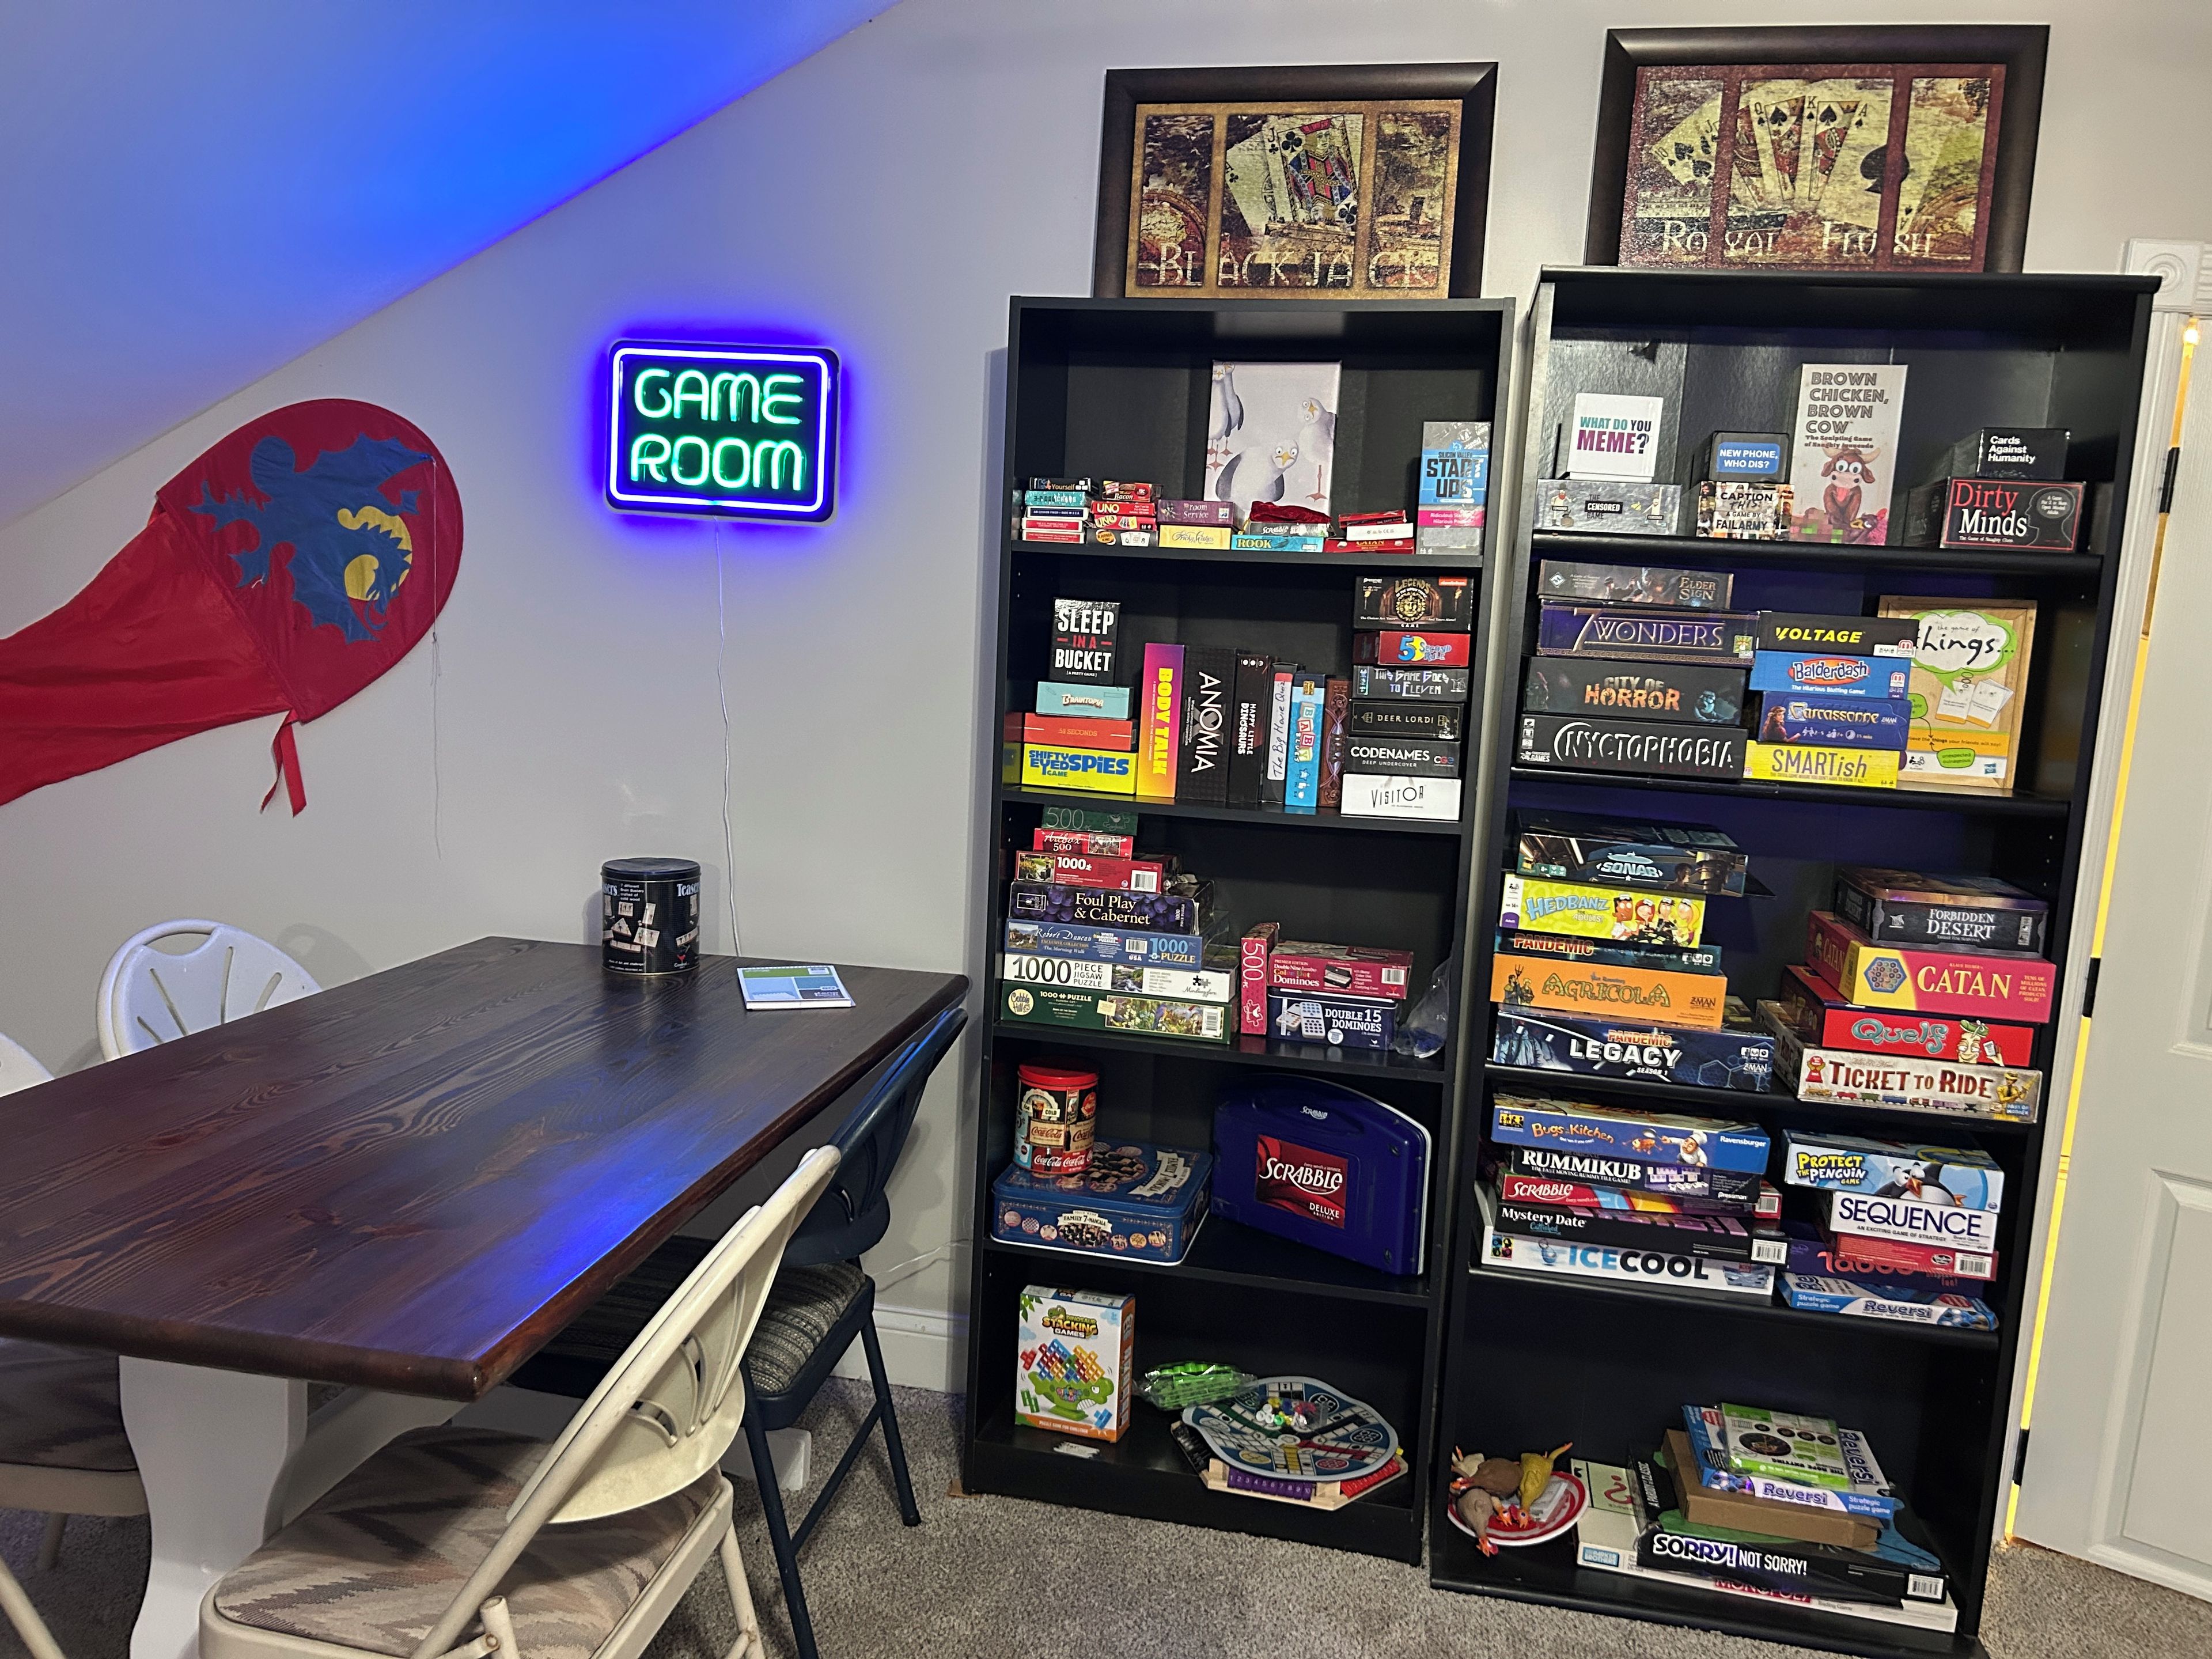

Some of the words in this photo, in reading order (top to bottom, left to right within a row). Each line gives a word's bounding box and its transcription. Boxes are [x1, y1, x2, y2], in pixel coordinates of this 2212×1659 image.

[1158, 242, 1294, 286] BLACK
[1305, 250, 1432, 287] JACK
[1811, 372, 1877, 387] BROWN
[634, 369, 804, 425] GAME
[1809, 388, 1889, 404] CHICKEN,
[1807, 404, 1873, 418] BROWN
[1580, 416, 1611, 429] WHAT
[1612, 418, 1628, 431] DO
[1630, 419, 1652, 432] YOU
[1805, 421, 1850, 434] COW
[1576, 429, 1650, 454] MEME?
[1990, 435, 2021, 444] Cards
[1719, 449, 1741, 457] NEW
[1743, 450, 1778, 459] PHONE,
[1988, 445, 2027, 454] Against
[630, 433, 803, 491] ROOM
[1724, 460, 1747, 468] WHO
[1748, 460, 1770, 469] DIS?
[1987, 453, 2036, 464] Humanity
[1426, 458, 1484, 478] START
[1435, 479, 1474, 498] UPS
[1721, 492, 1773, 501] CAPTION
[1587, 502, 1621, 512] CENSORED
[1953, 483, 2019, 517] Dirty
[1096, 503, 1120, 514] UNO
[1183, 511, 1209, 519] Service
[1094, 514, 1118, 528] UNO
[1958, 508, 2028, 537] Minds
[1236, 538, 1272, 549] ROOK
[1395, 578, 1432, 594] LEGENDS
[1679, 576, 1717, 591] ELDER
[1679, 589, 1715, 601] SIGN
[1057, 608, 1115, 635] SLEEP
[1073, 635, 1086, 648] IN
[1089, 636, 1097, 649] A
[1775, 627, 1862, 643] VOLTAGE
[1055, 648, 1112, 672] BUCKET
[1373, 668, 1393, 680] THIS
[1395, 669, 1421, 683] GAME
[1422, 671, 1449, 684] GOES
[1793, 660, 1869, 681] Balderdash
[1389, 683, 1401, 693] TO
[1402, 681, 1442, 697] ELEVEN
[1603, 676, 1641, 690] CITY
[1643, 677, 1664, 690] OF
[1827, 686, 1848, 694] Bluffing
[1156, 668, 1173, 724] BODY
[1275, 681, 1286, 702] Quiz
[1584, 683, 1681, 711] HORROR
[1062, 694, 1104, 708] BRAINTOPIA
[1248, 703, 1257, 728] HAPPY
[1274, 707, 1285, 733] Movie
[1789, 702, 1880, 724] Carcassonne
[1191, 671, 1223, 773] ANOMIA
[1237, 702, 1250, 755] DINOSAURS
[1298, 707, 1315, 758] BABY
[1246, 730, 1255, 755] LITTLE
[1272, 736, 1286, 755] Big
[1294, 732, 1302, 763] BLUES
[1152, 726, 1170, 776] TALK
[1531, 755, 1550, 763] GAMES
[1030, 757, 1070, 776] EYED
[1273, 757, 1283, 778] The
[1771, 748, 1868, 778] SMARTish
[1046, 770, 1068, 778] GAME
[1371, 785, 1425, 808] VISITOR
[1052, 843, 1073, 851] 500
[1056, 856, 1088, 870] 1000
[1075, 892, 1105, 907] Foul
[1108, 895, 1137, 911] Play
[1525, 895, 1611, 922] HEDBANZ
[1074, 907, 1086, 919] &
[1089, 908, 1151, 925] Cabernet
[1573, 914, 1604, 923] ADULTS!
[1929, 908, 1995, 923] FORBIDDEN
[1035, 926, 1061, 939] Robert
[1058, 929, 1092, 942] Duncan
[1926, 918, 1997, 940] DESERT
[1513, 933, 1595, 956] PANDEMIC
[1160, 952, 1196, 964] PUZZLE
[1012, 956, 1072, 984] 1000
[1073, 971, 1103, 979] JIGSAW
[1074, 963, 1104, 973] PIECE
[1073, 978, 1103, 988] PUZZLE
[1273, 974, 1321, 987] Dominoes
[1916, 965, 2013, 999] CATAN
[1010, 991, 1030, 1005] Cobble
[1040, 990, 1059, 998] 1000
[1067, 993, 1093, 1002] PUZZLE
[1012, 1002, 1024, 1013] Hill
[1324, 1008, 1363, 1021] DOUBLE
[1364, 1009, 1382, 1023] 15
[1332, 1019, 1382, 1033] DOMINOES
[1607, 1029, 1673, 1048] PANDEMIC
[1851, 1018, 1949, 1054] Quelf
[1569, 1038, 1683, 1069] LEGACY
[1828, 1059, 1911, 1091] TICKET
[1913, 1074, 1934, 1090] TO
[1939, 1070, 1994, 1099] RIDE
[1300, 1105, 1328, 1120] SCRABBLE
[1531, 1123, 1565, 1138] Bugs
[1569, 1124, 1615, 1144] Kitchen
[1719, 1135, 1767, 1148] Ravensburger
[1521, 1149, 1642, 1180] RUMMIKUB
[1797, 1152, 1864, 1169] PROTECT
[1259, 1157, 1343, 1195] SCRABBLE
[1508, 1182, 1574, 1203] SCRABBLE
[1718, 1191, 1748, 1200] Pressman
[1309, 1202, 1340, 1219] DELUXE
[1313, 1211, 1334, 1221] EDITION
[1501, 1207, 1554, 1226] Mystery
[1555, 1214, 1586, 1229] Date
[1838, 1196, 1983, 1237] SEQUENCE
[1866, 1226, 1891, 1234] EXCITING
[1918, 1233, 1947, 1242] STRATEGY
[1798, 1294, 1831, 1303] Strategic
[1863, 1300, 1933, 1319] Reversi
[1042, 1316, 1098, 1335] STACKING
[1055, 1328, 1085, 1338] GAMES
[1842, 1431, 1884, 1486] Reversi
[1763, 1482, 1828, 1505] Reversi
[1848, 1495, 1881, 1506] Strategic
[1848, 1503, 1870, 1511] puzzle
[1870, 1505, 1891, 1514] game
[1653, 1532, 1738, 1567] SORRY!
[1738, 1549, 1761, 1569] NOT
[1763, 1552, 1807, 1575] SORRY!
